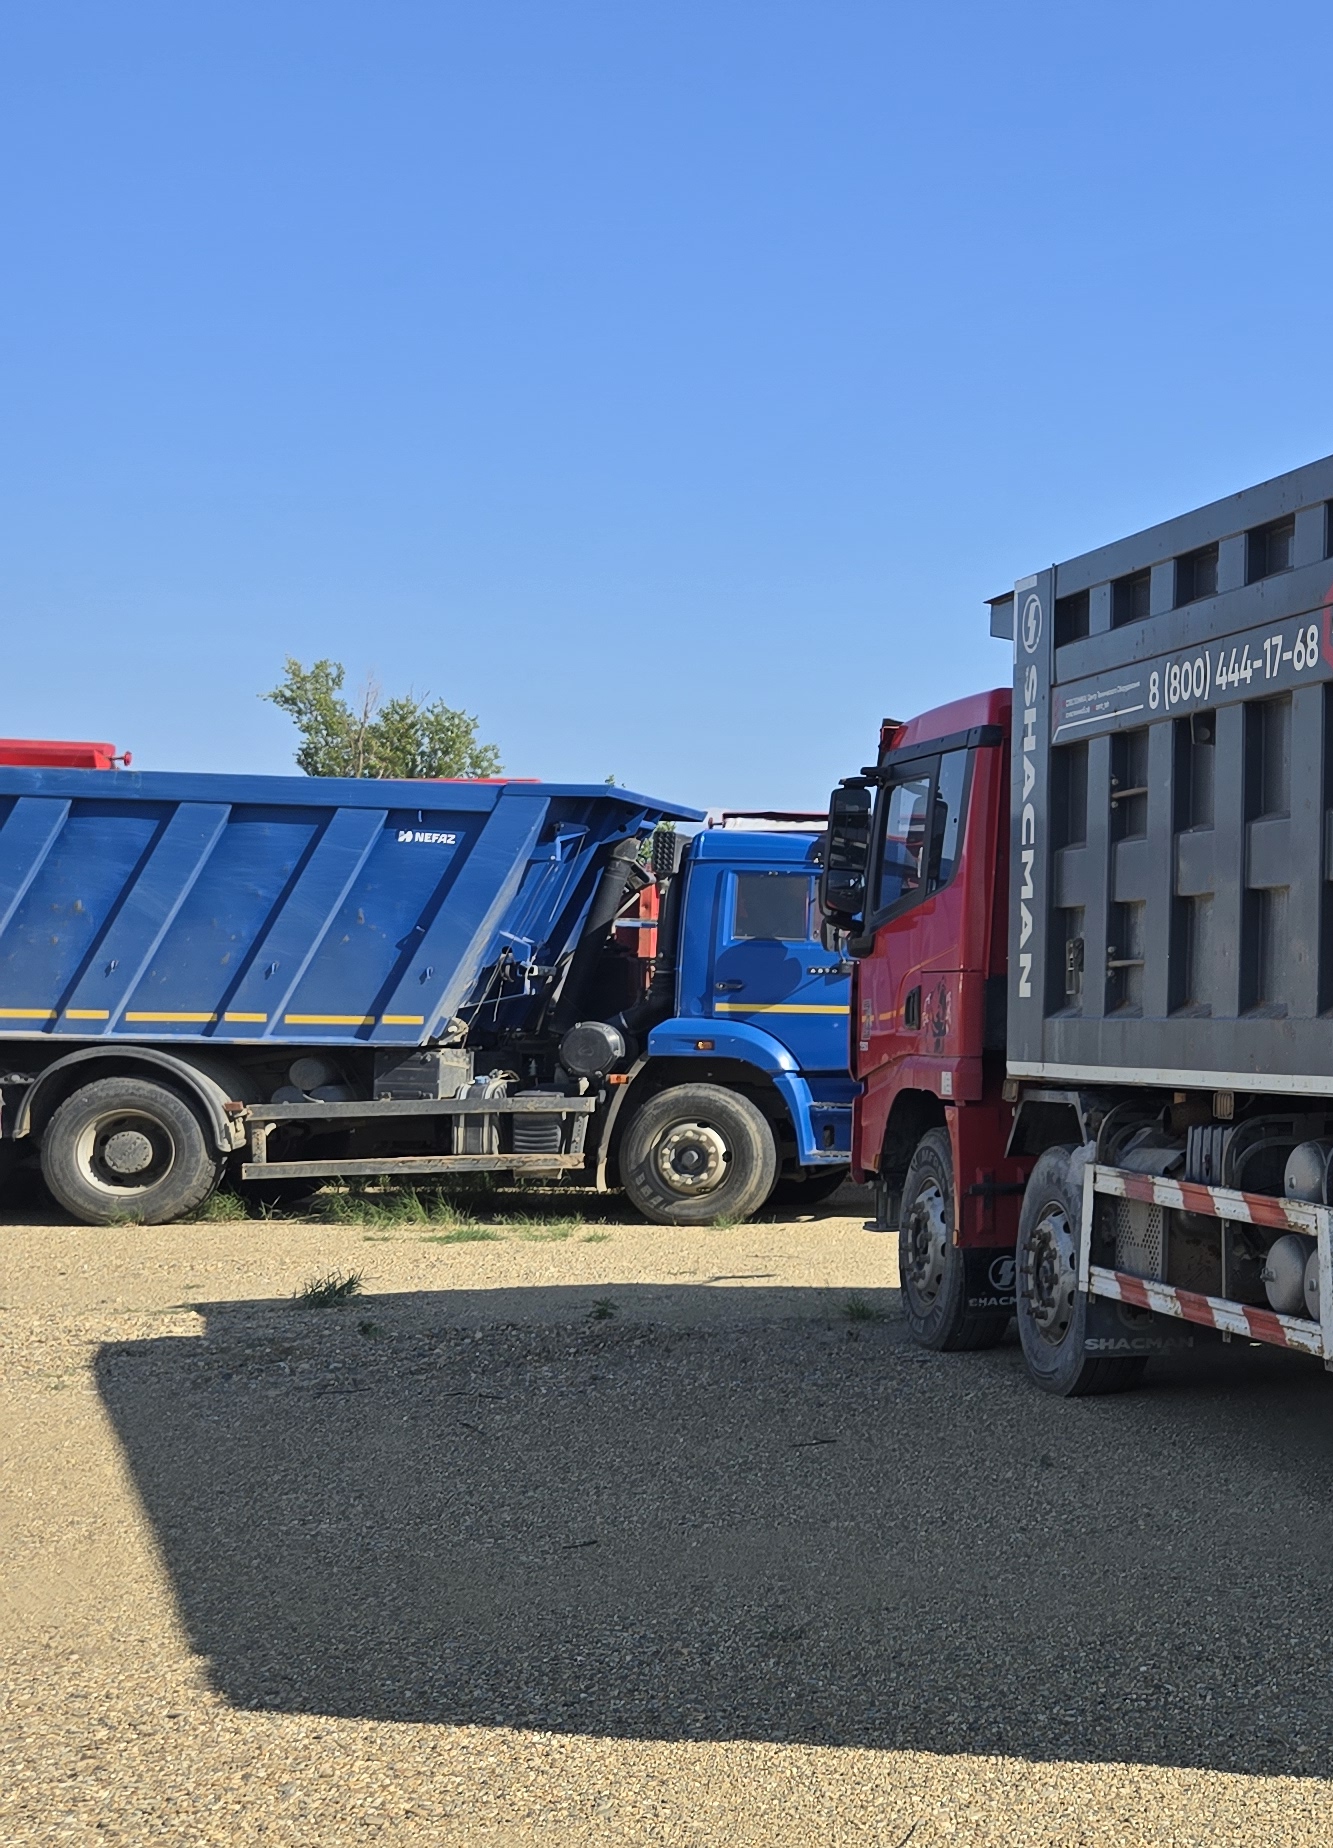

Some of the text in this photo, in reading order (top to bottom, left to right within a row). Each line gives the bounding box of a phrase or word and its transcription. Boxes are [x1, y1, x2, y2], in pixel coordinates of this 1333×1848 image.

[1149, 671, 1160, 710] 8
[1164, 651, 1211, 710] (800)
[1215, 624, 1319, 691] 444-17-68
[414, 831, 456, 845] NEFAZ
[1018, 663, 1038, 998] SHACMAN
[1084, 1335, 1195, 1351] SHACMAN
